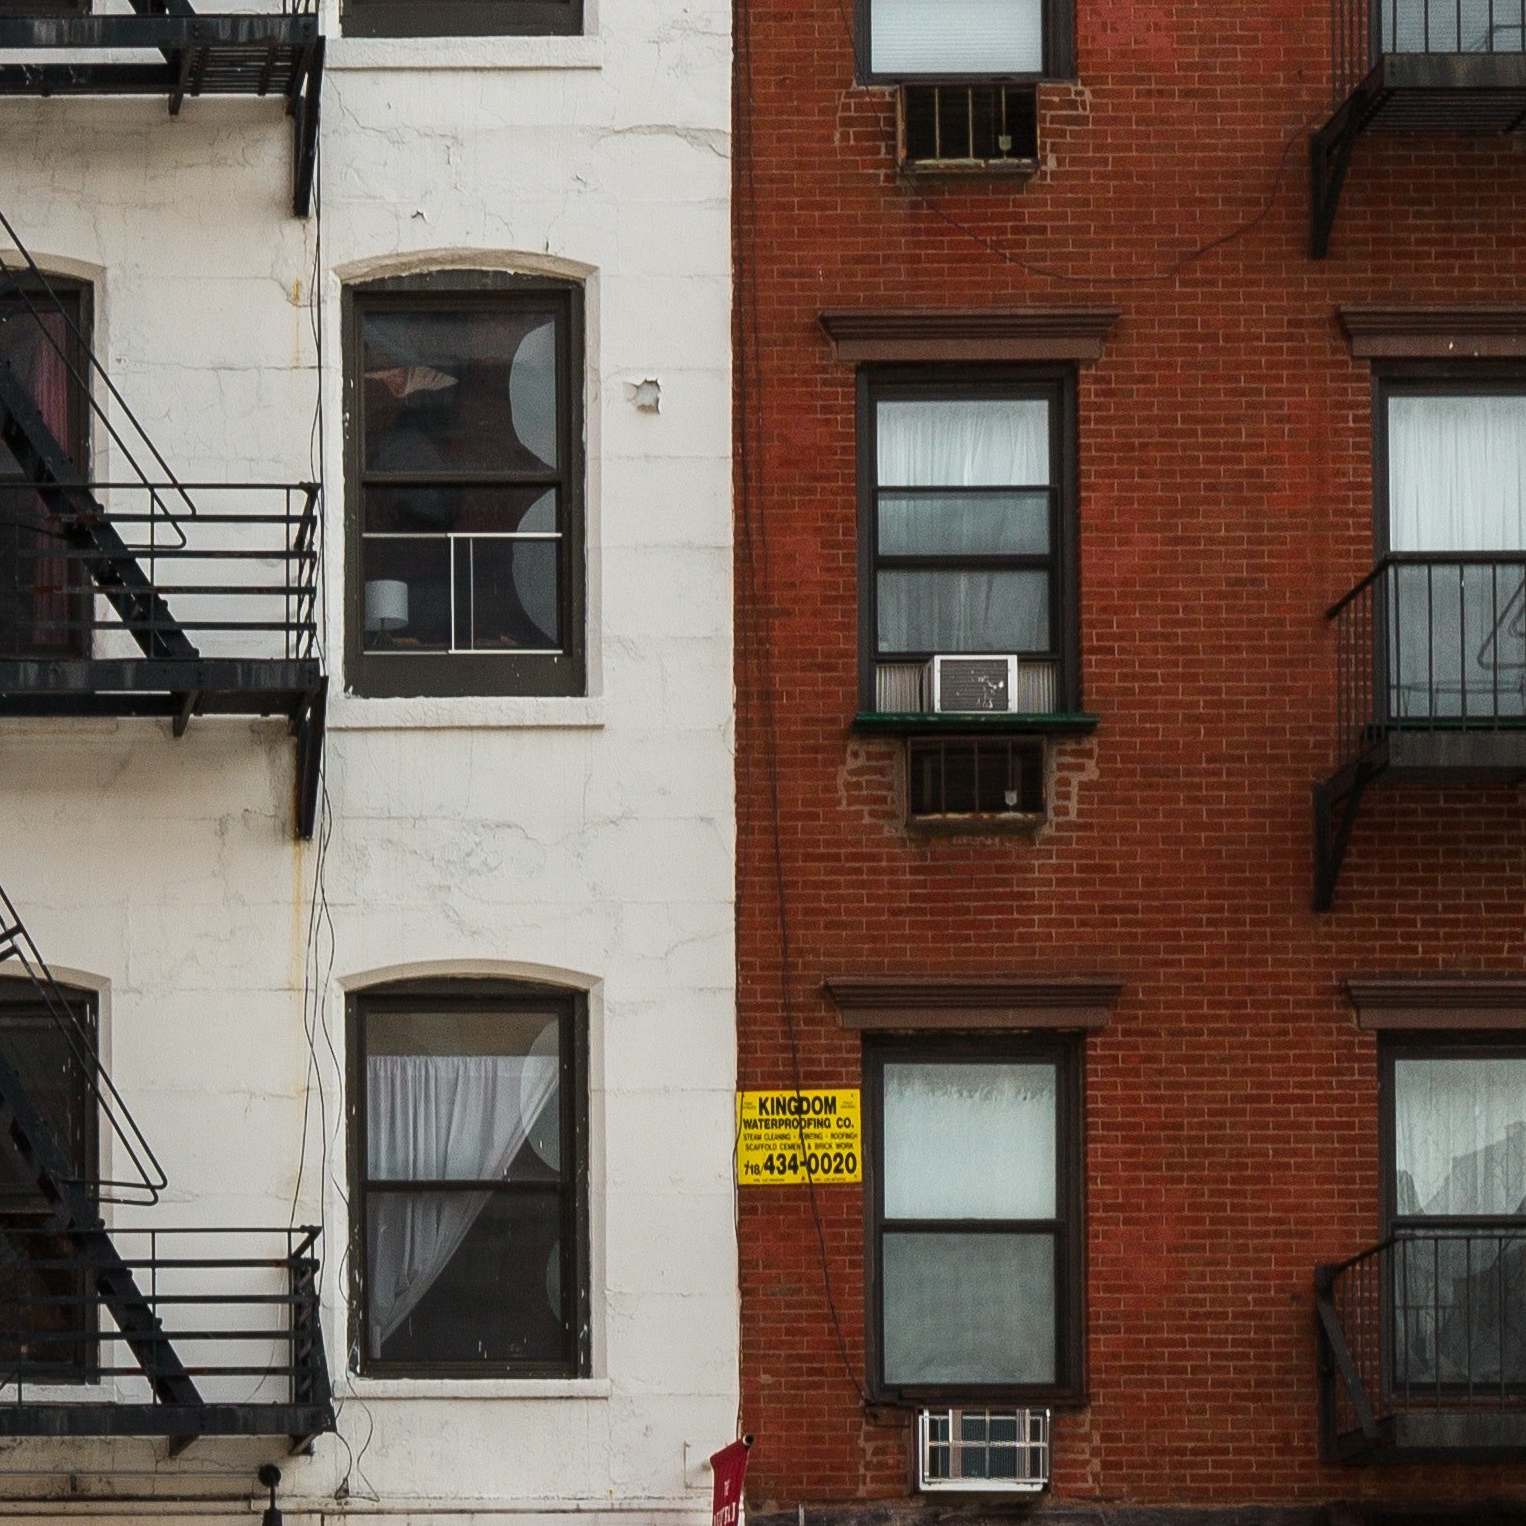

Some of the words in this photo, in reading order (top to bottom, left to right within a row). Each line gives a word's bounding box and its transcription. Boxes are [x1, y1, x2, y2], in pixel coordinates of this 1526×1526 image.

[758, 1096, 837, 1115] KINGDOM
[743, 1118, 831, 1130] WATERPROOFING
[836, 1117, 854, 1129] CO.
[779, 1142, 804, 1151] CEMEN
